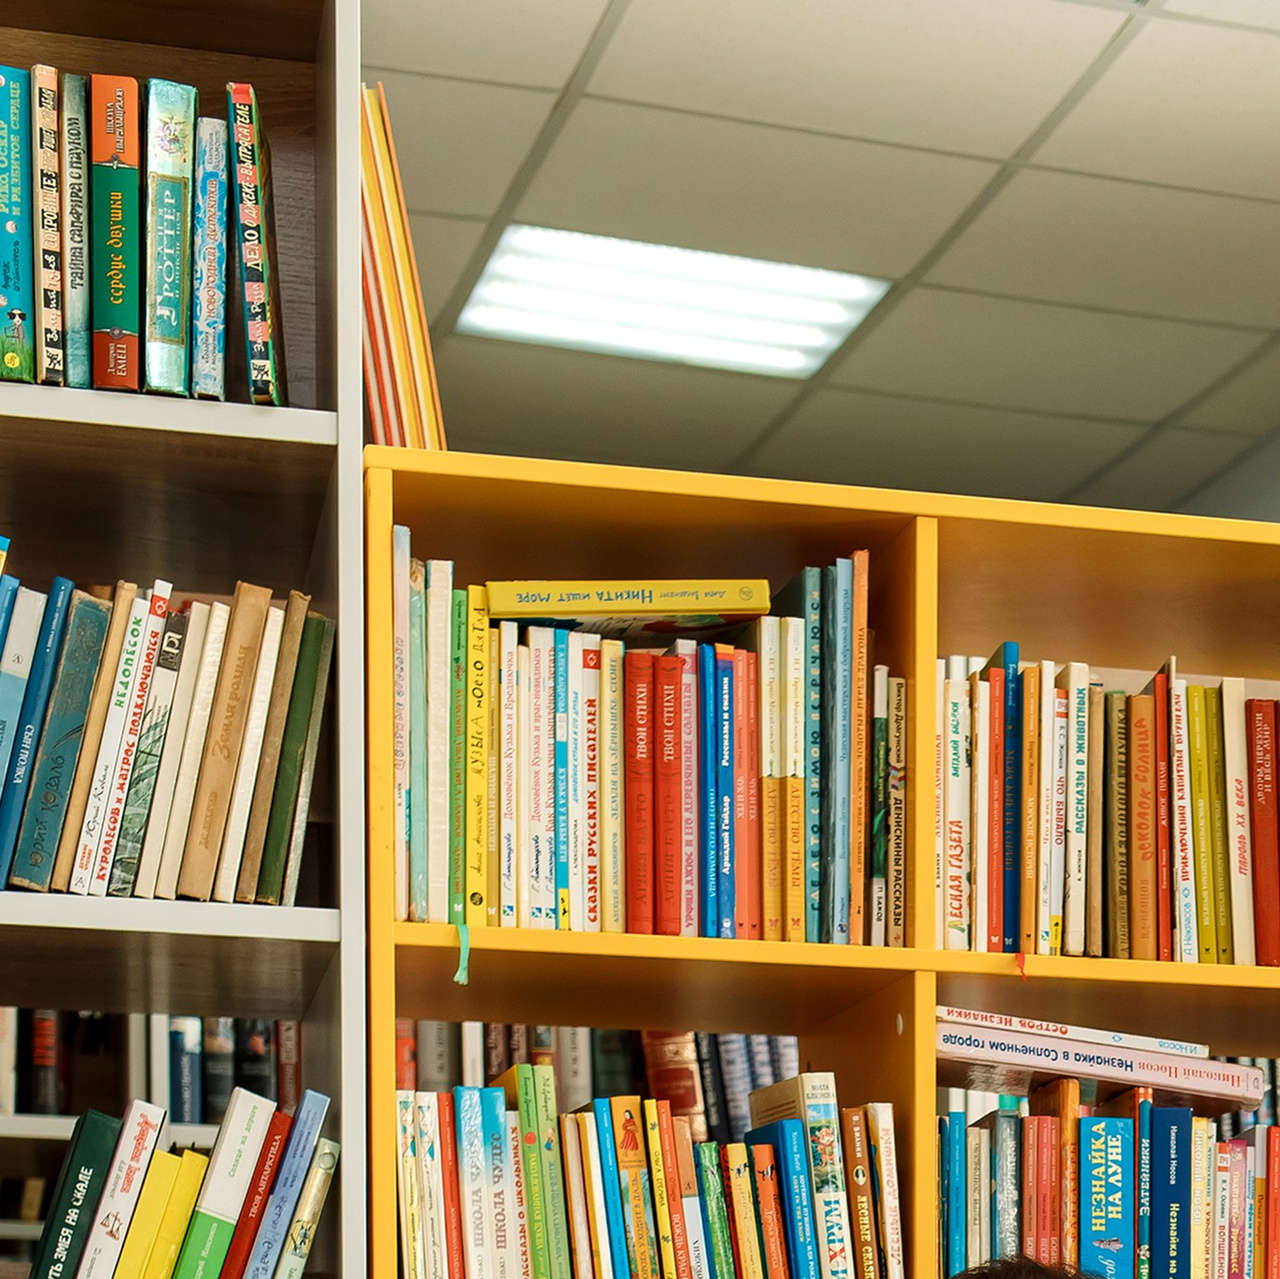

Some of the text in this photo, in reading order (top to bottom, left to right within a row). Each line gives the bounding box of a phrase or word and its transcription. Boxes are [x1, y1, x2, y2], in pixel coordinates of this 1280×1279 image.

[246, 230, 263, 272] ДЕЛО
[989, 1041, 1058, 1061] Солнечном
[1074, 1052, 1133, 1071] Незнайка
[70, 1165, 93, 1206] СКАЛЕ
[1091, 1121, 1106, 1231] НЕЗНАЙКА
[1108, 1135, 1122, 1219] НА ЛУНЕ
[65, 1209, 78, 1225] НА
[54, 1228, 73, 1261] ЗМЕЯ
